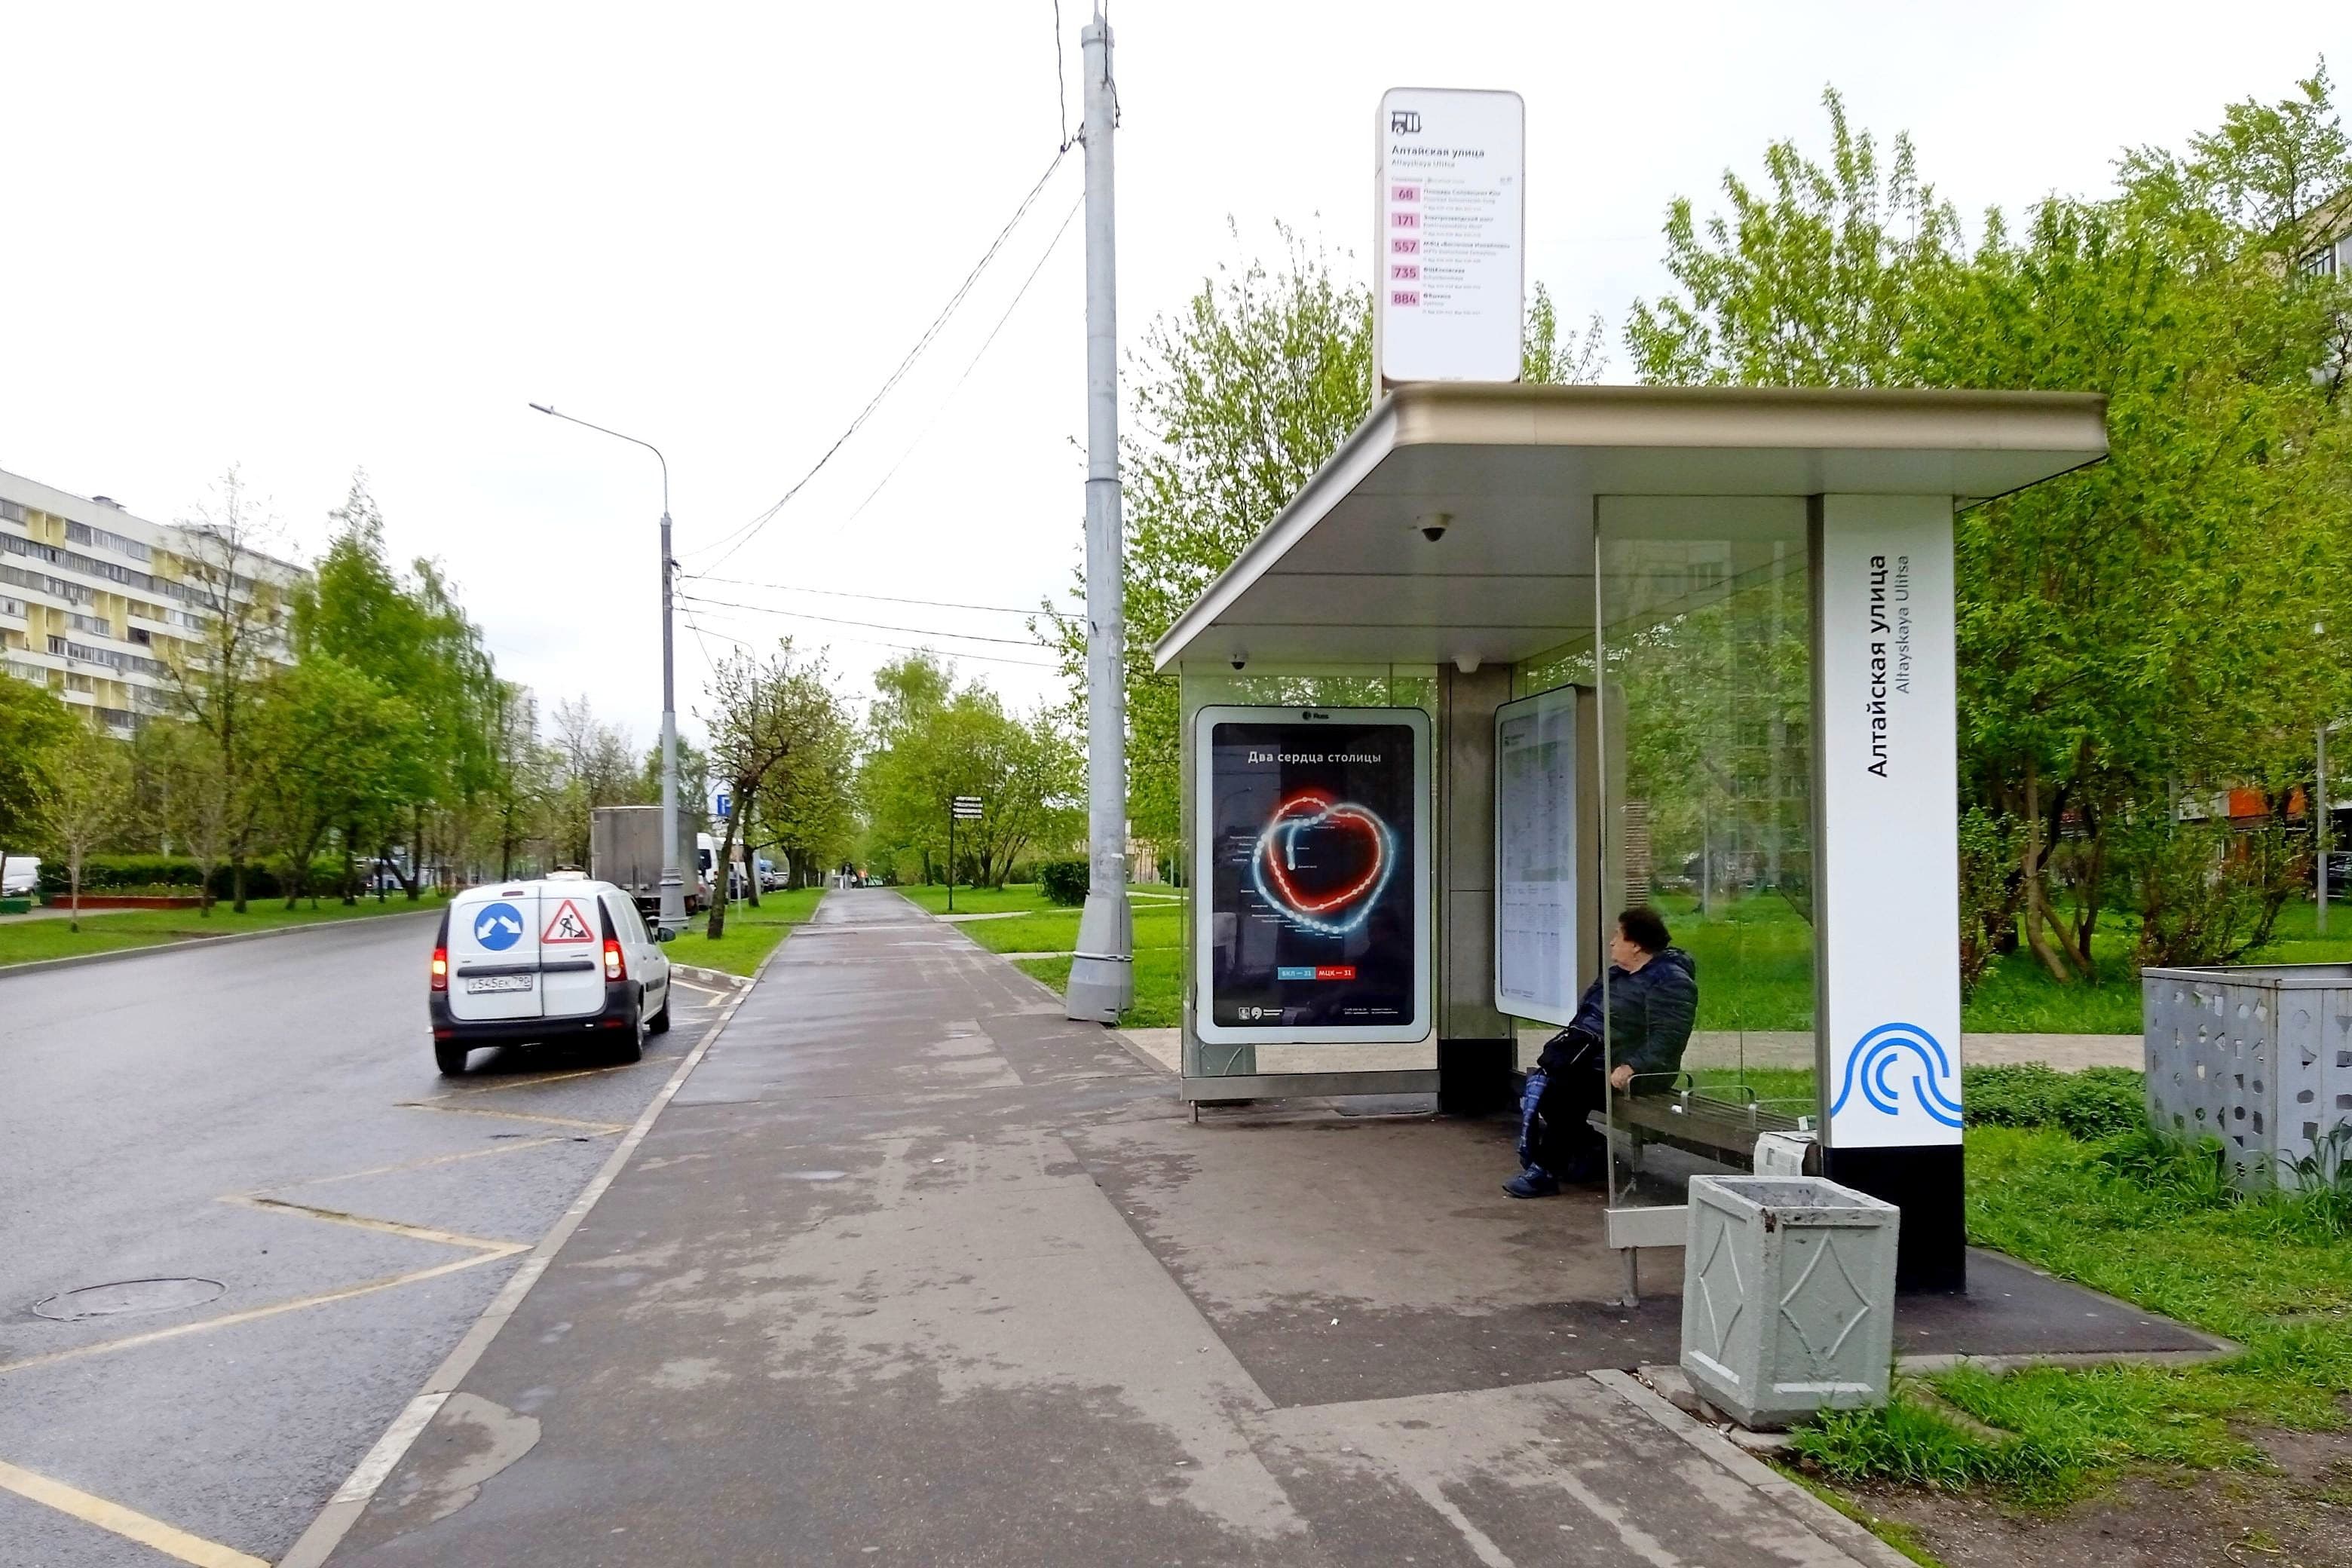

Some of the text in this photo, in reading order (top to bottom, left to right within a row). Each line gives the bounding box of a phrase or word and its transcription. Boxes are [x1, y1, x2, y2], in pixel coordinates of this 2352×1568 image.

[1392, 145, 1485, 159] Алтайская улица
[1398, 189, 1413, 201] 68
[1398, 216, 1413, 225] 171
[1395, 241, 1416, 253] 557
[1395, 268, 1416, 278] 735
[1394, 292, 1416, 305] 884
[1894, 555, 1913, 694] Altayskaya Ulitsa
[1867, 555, 1891, 778] Алтайская улица
[1248, 751, 1381, 764] Два сердца столицы
